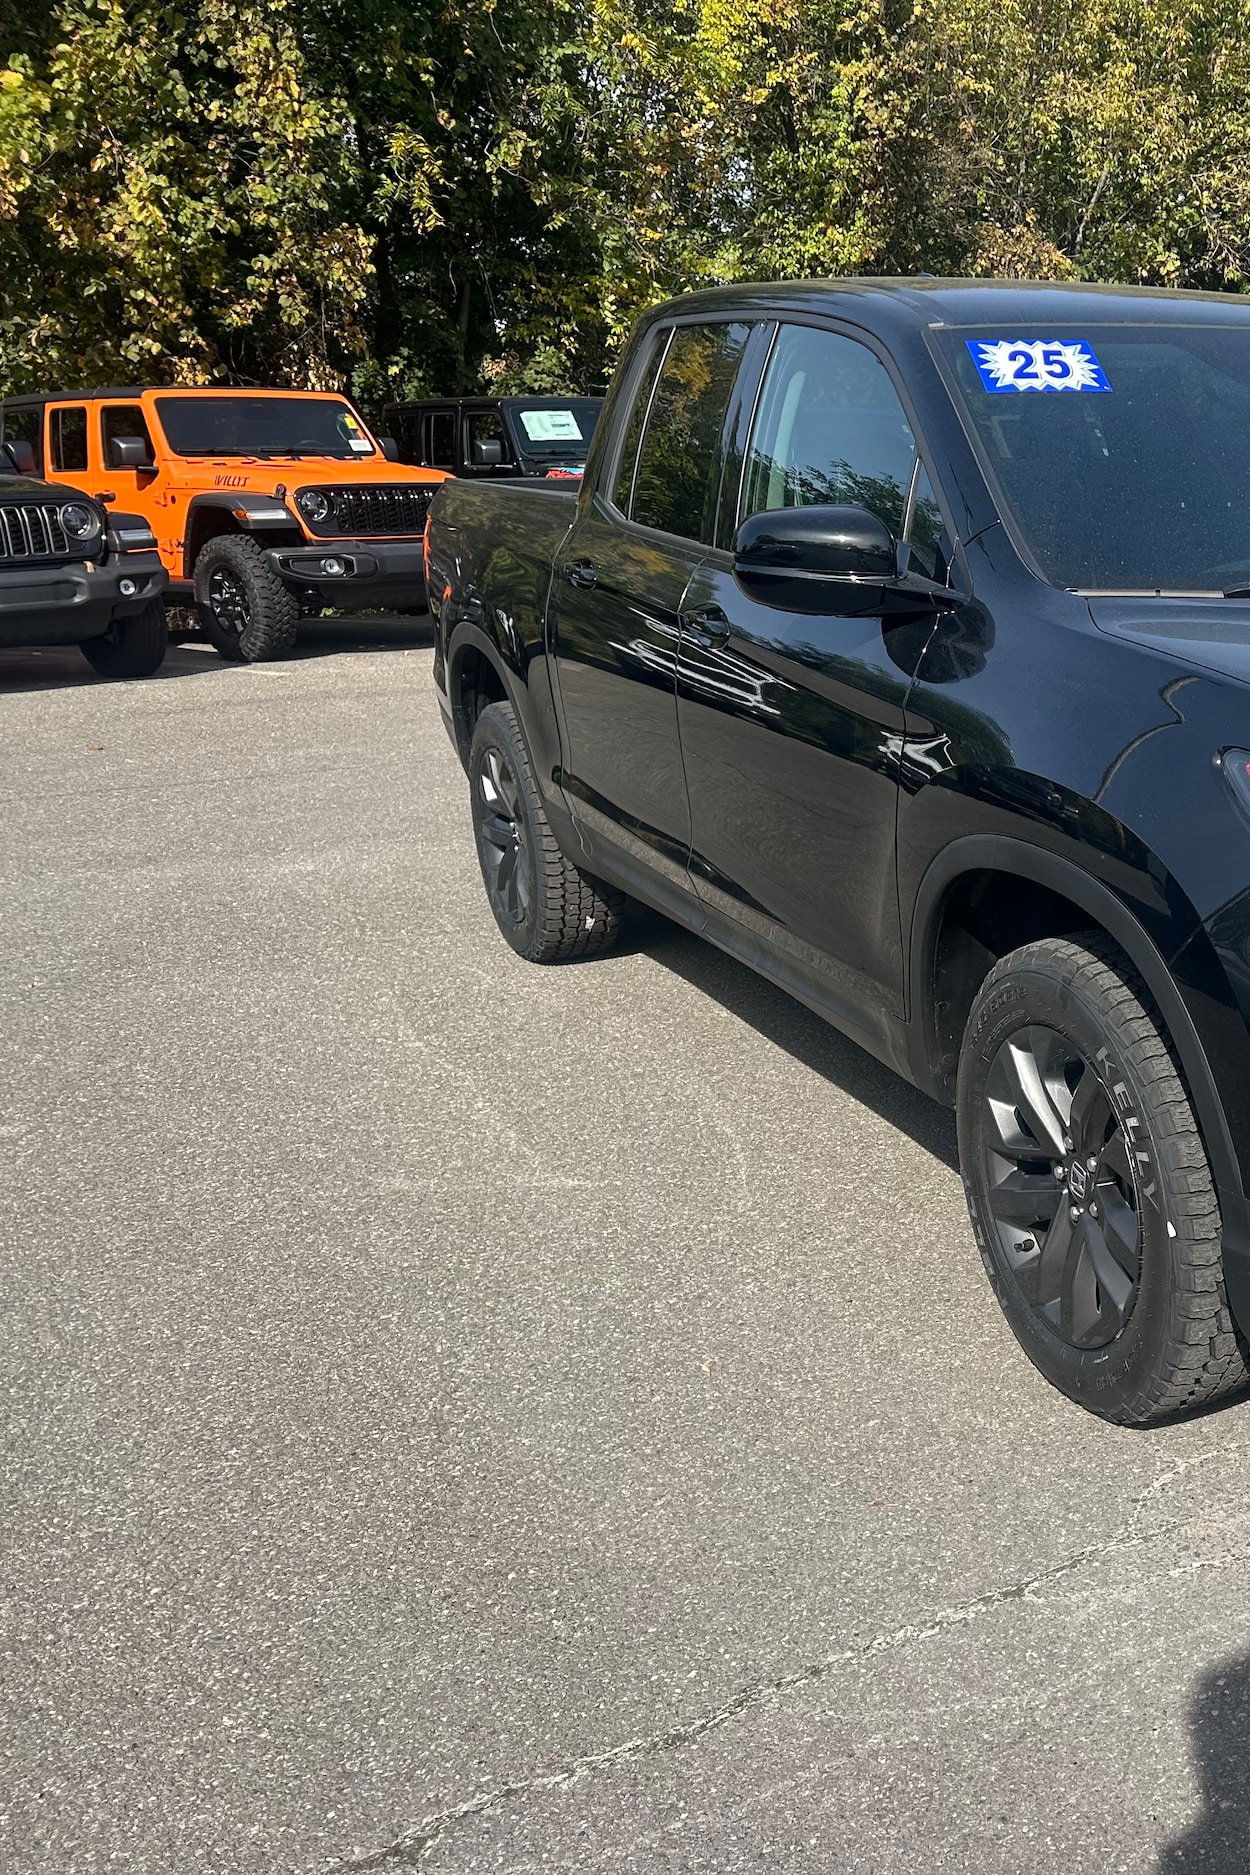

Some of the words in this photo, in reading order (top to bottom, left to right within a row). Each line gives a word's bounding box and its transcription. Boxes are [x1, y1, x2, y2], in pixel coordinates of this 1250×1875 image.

[1008, 349, 1071, 379] 25
[214, 475, 250, 487] WILLYS
[1095, 1046, 1161, 1214] KELLY
